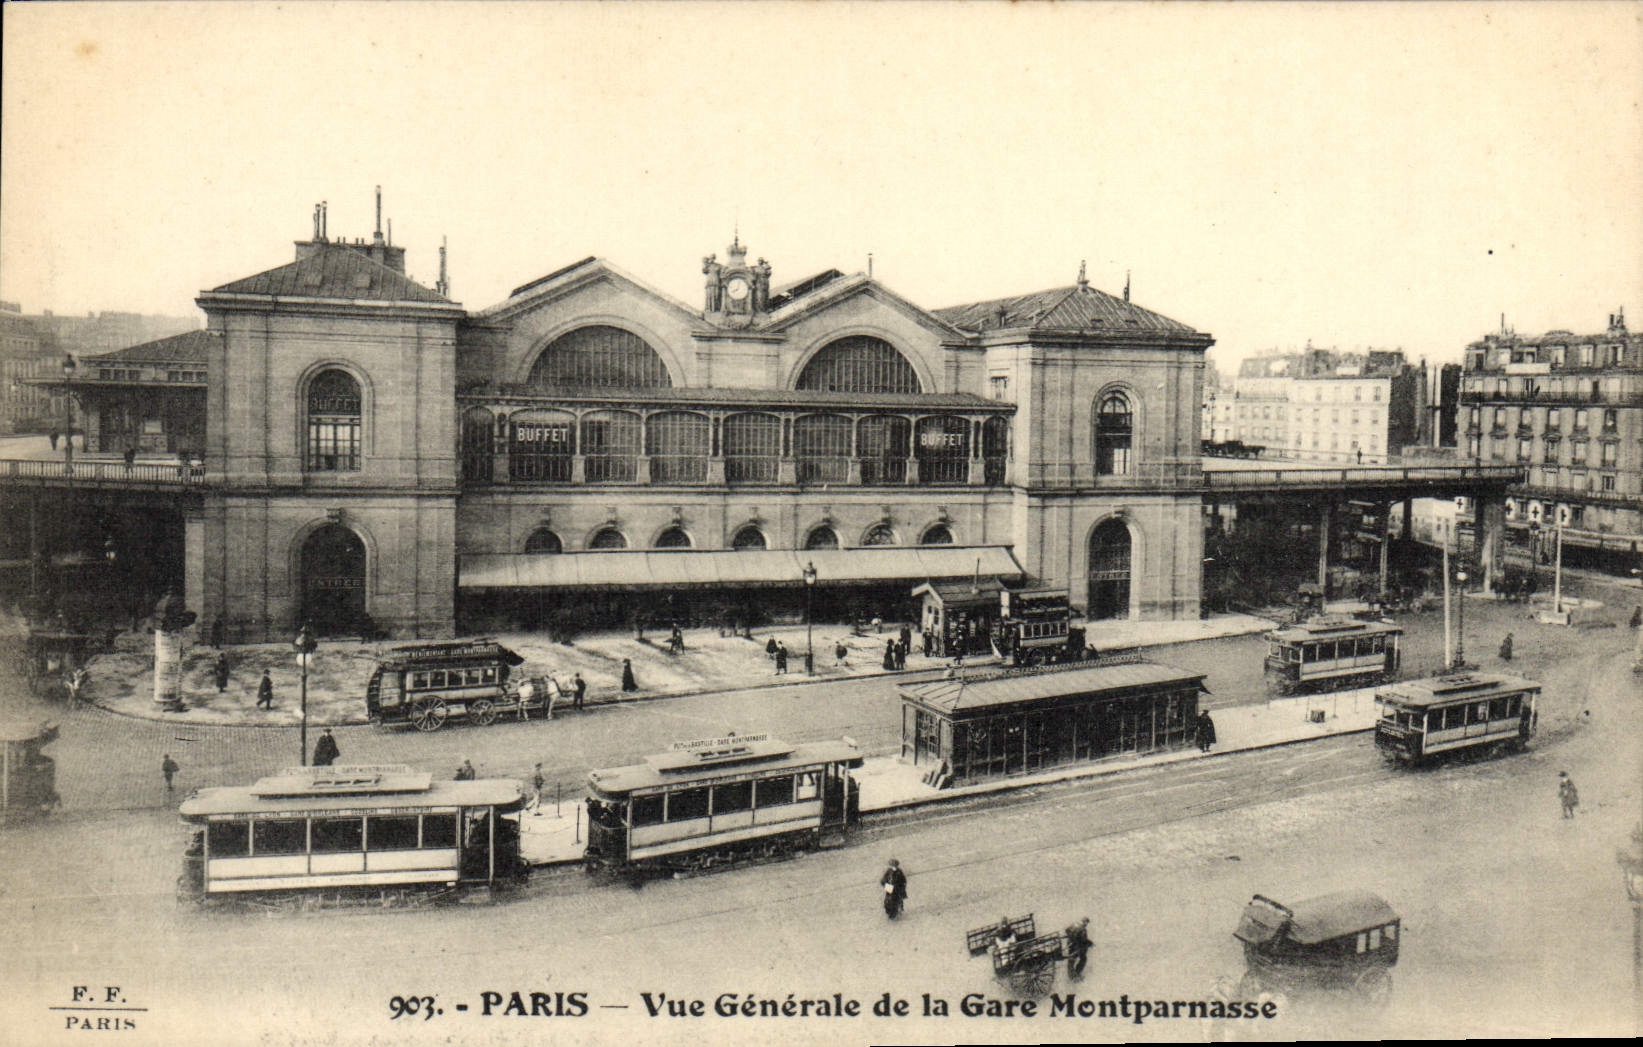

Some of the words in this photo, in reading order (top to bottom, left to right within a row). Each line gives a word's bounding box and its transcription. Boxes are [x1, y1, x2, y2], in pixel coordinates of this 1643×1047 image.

[311, 397, 360, 411] BUFFET
[518, 427, 568, 442] BUFFET
[921, 433, 964, 446] BUFFET
